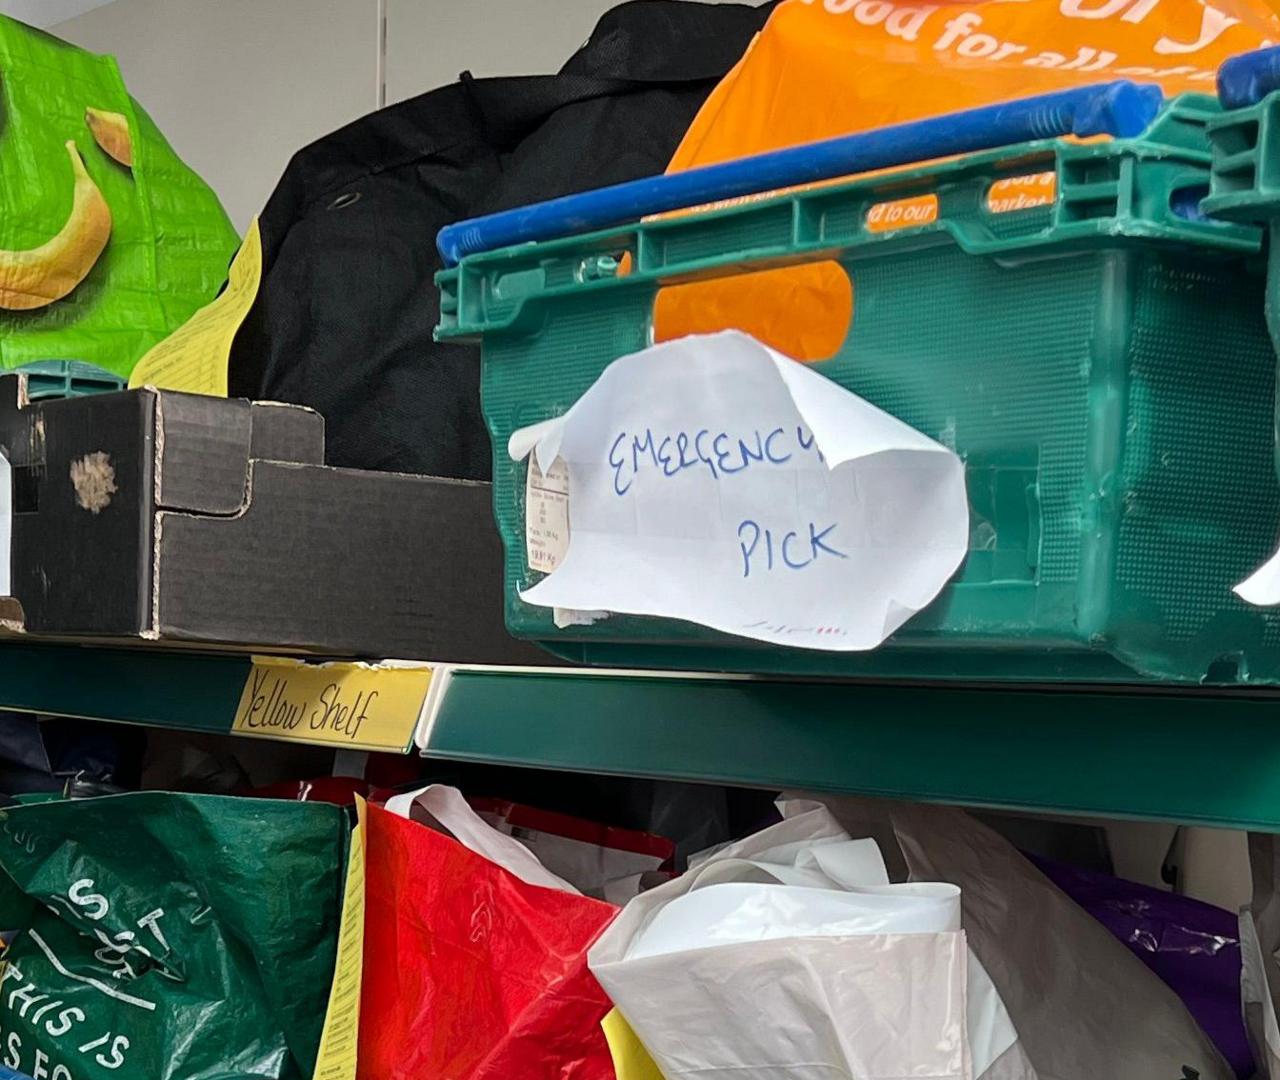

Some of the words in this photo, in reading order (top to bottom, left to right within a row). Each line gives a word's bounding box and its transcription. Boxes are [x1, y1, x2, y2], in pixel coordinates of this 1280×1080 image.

[932, 11, 1025, 61] for
[1024, 47, 1118, 72] all
[885, 204, 903, 221] to
[904, 203, 933, 222] our
[736, 519, 848, 578] PICK
[241, 668, 306, 729] Yellow
[310, 683, 379, 739] Shelf
[92, 1024, 131, 1070] IS
